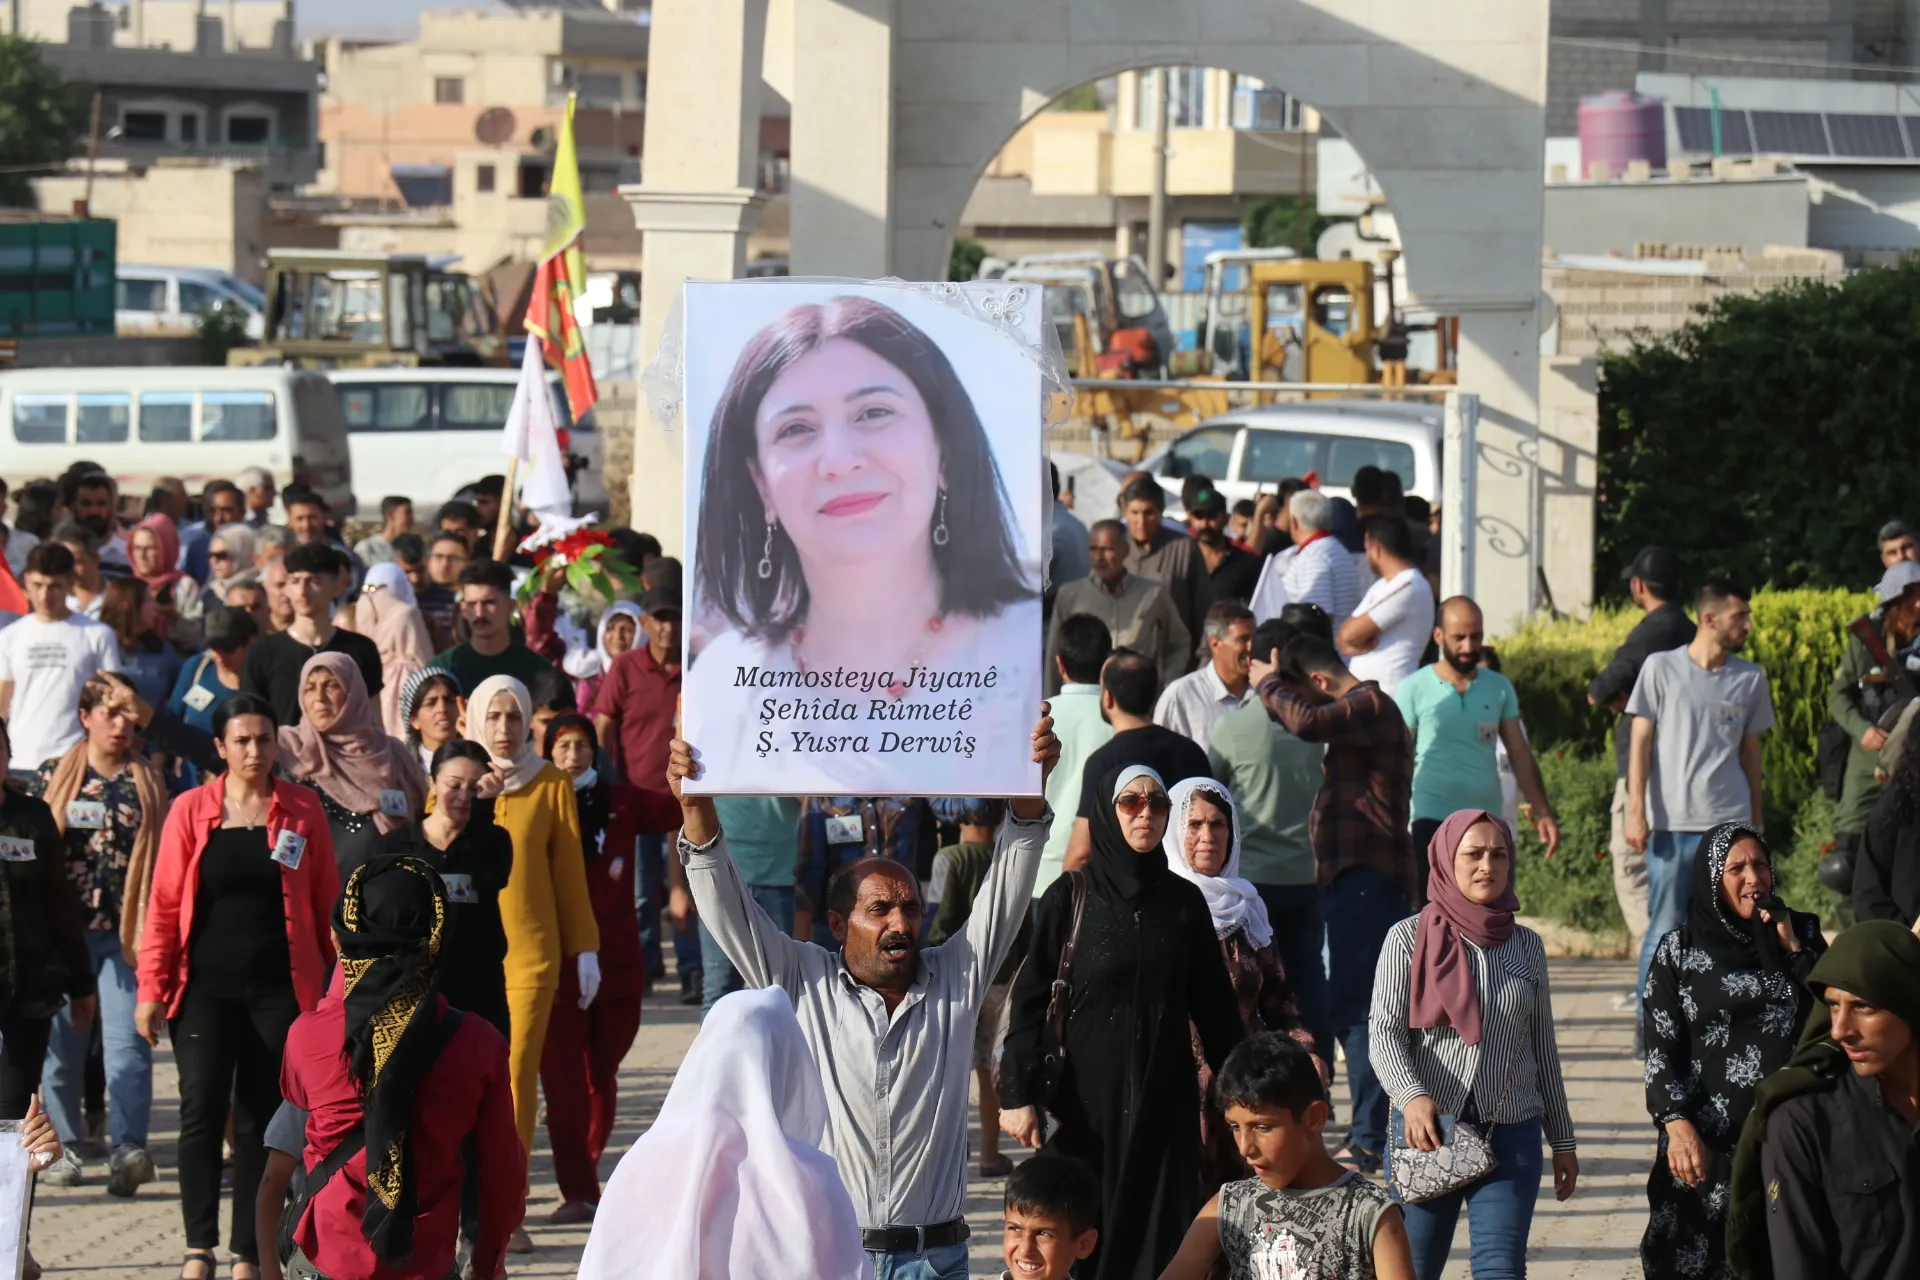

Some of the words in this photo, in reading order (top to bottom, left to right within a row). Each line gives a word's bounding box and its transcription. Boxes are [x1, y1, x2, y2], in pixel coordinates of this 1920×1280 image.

[734, 666, 895, 693] Mamosteya
[902, 665, 998, 692] Jiyanê
[760, 697, 859, 725] Şehîda
[867, 696, 973, 721] Rûmetê
[756, 731, 780, 757] Ş.
[791, 731, 870, 753] Yusra
[879, 731, 977, 758] Derwîş
